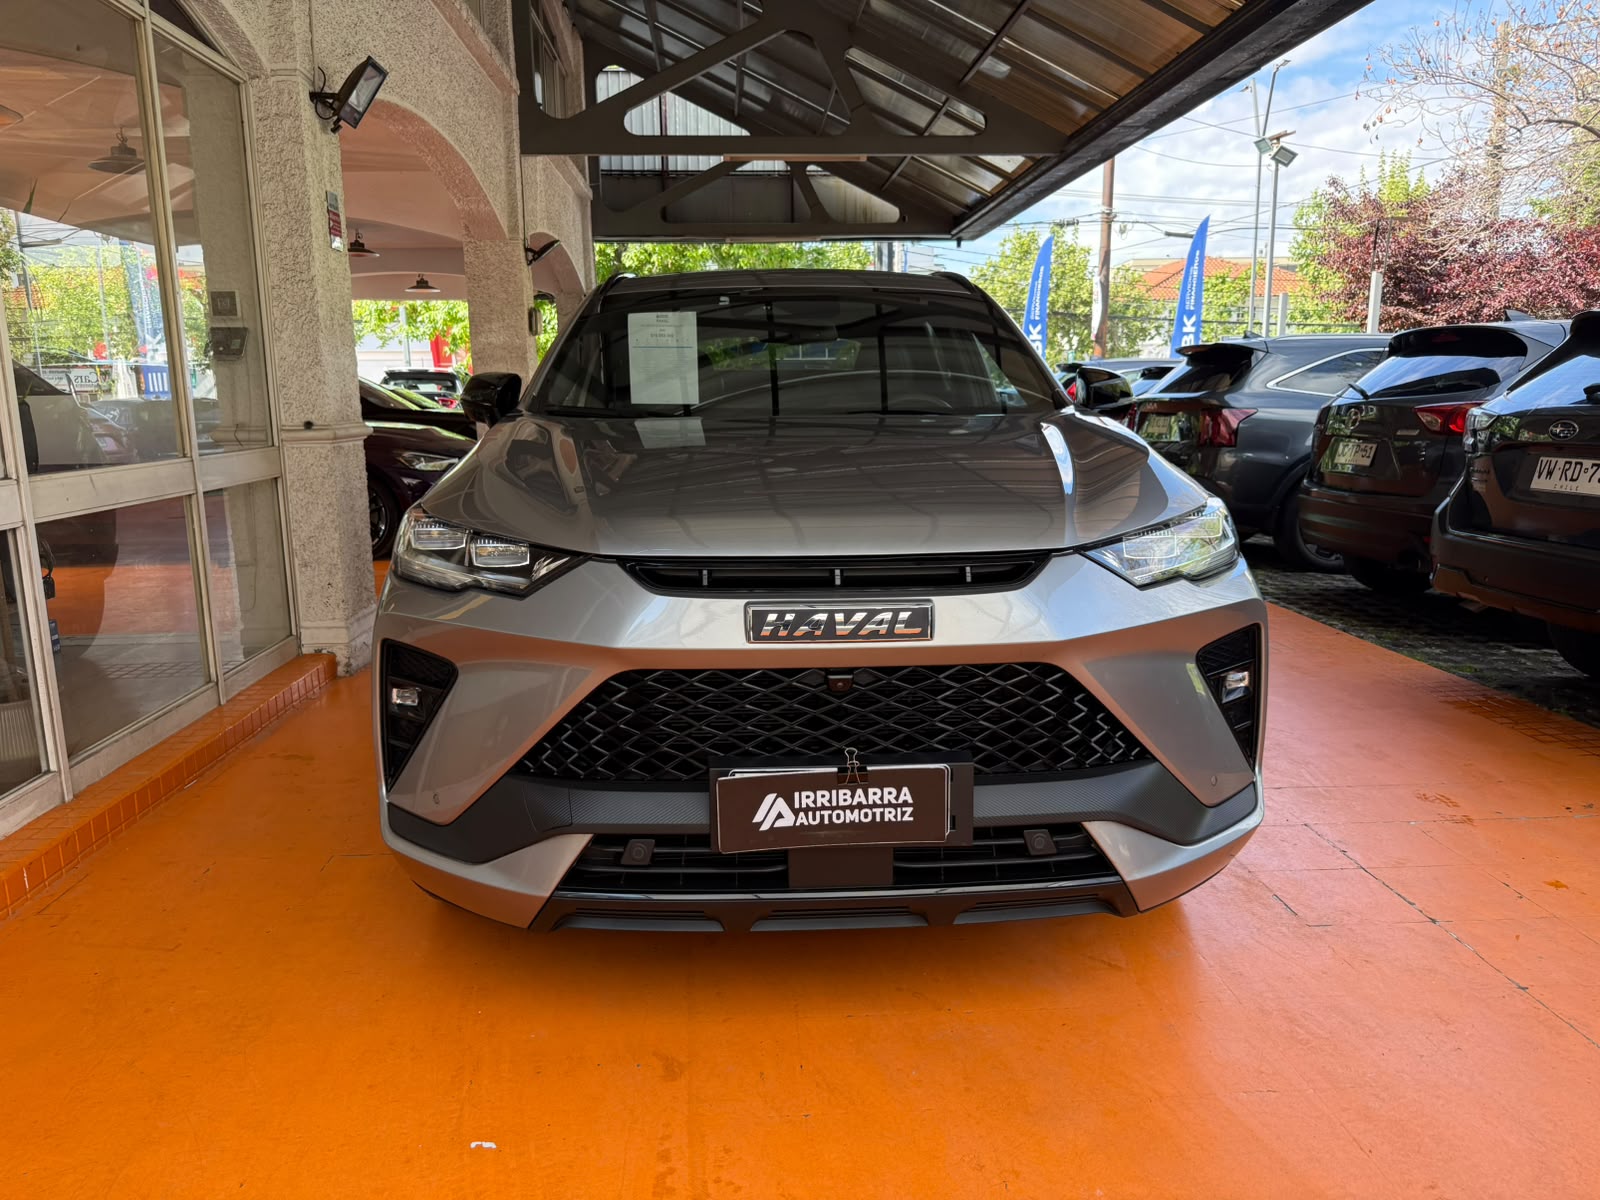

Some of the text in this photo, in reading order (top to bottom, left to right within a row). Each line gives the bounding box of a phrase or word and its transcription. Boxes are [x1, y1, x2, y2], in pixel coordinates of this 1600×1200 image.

[760, 611, 923, 637] HAVAL
[794, 786, 913, 809] IRRIBARRA
[795, 807, 914, 826] AUTOMOTRIZ
